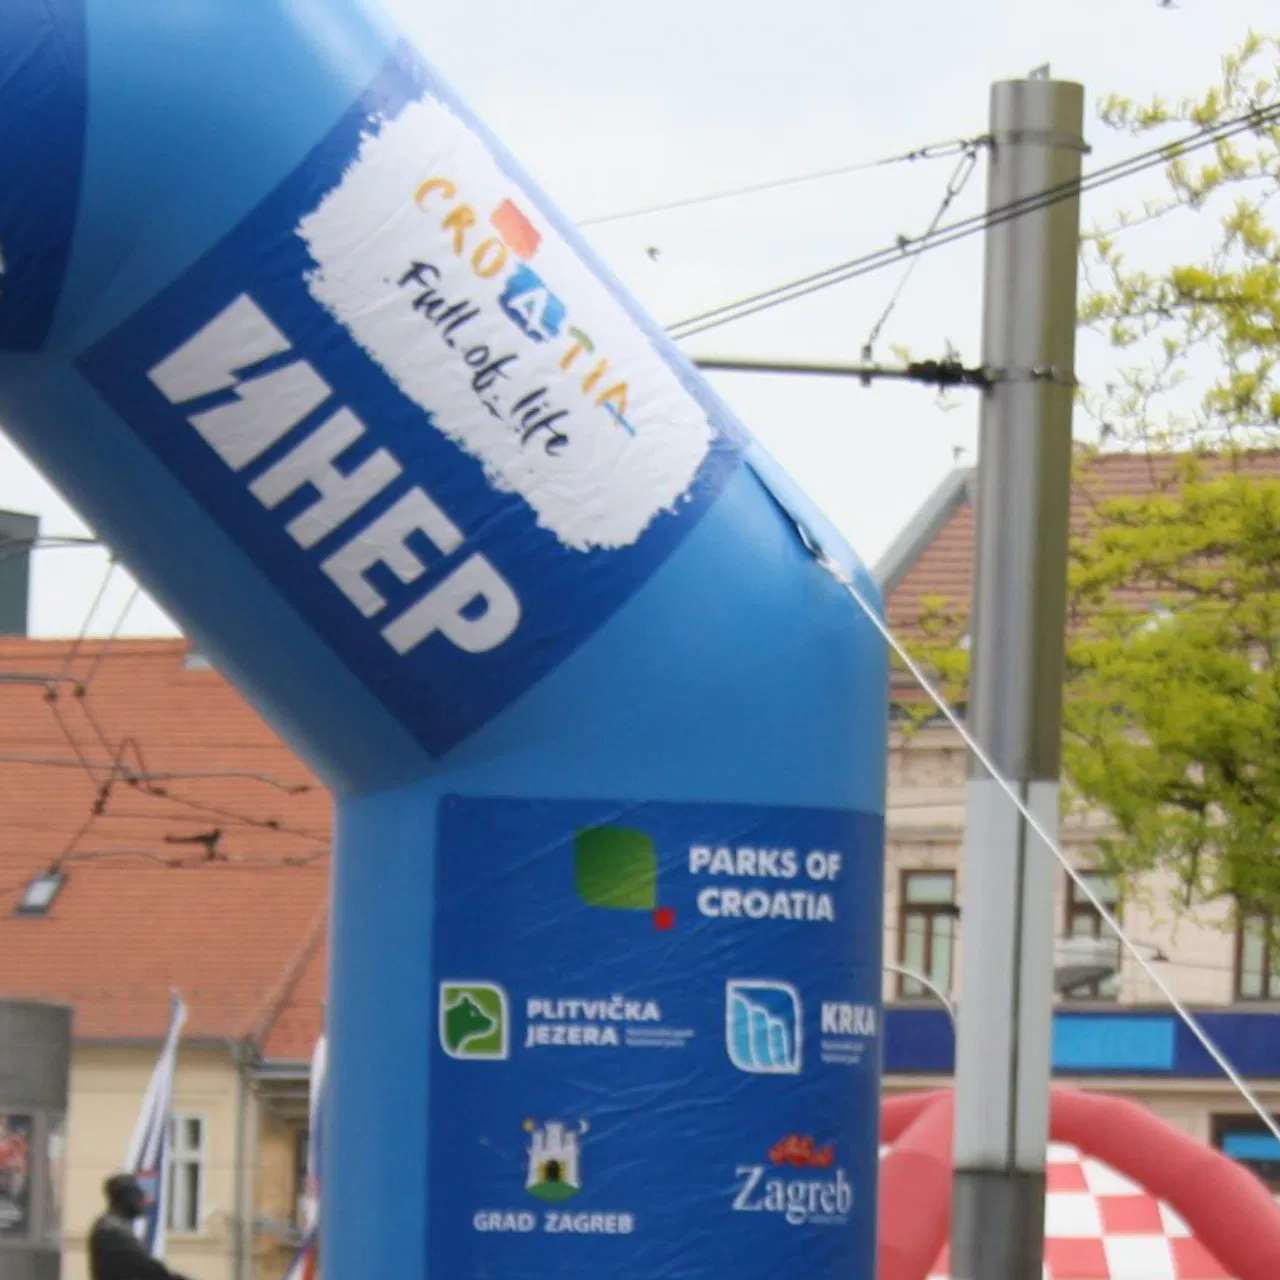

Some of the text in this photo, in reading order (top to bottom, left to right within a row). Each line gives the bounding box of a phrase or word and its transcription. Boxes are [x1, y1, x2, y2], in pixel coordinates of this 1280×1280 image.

[398, 261, 469, 350] Full
[511, 386, 571, 457] life
[688, 845, 842, 882] PARKS OF
[696, 888, 834, 922] CROATIA
[526, 993, 661, 1023] PLITVIČKA
[821, 1002, 877, 1037] KRKA
[526, 1024, 619, 1048] JEZERA
[732, 1164, 852, 1226] Zagreb
[472, 1211, 635, 1235] GRAD ZAGREB
